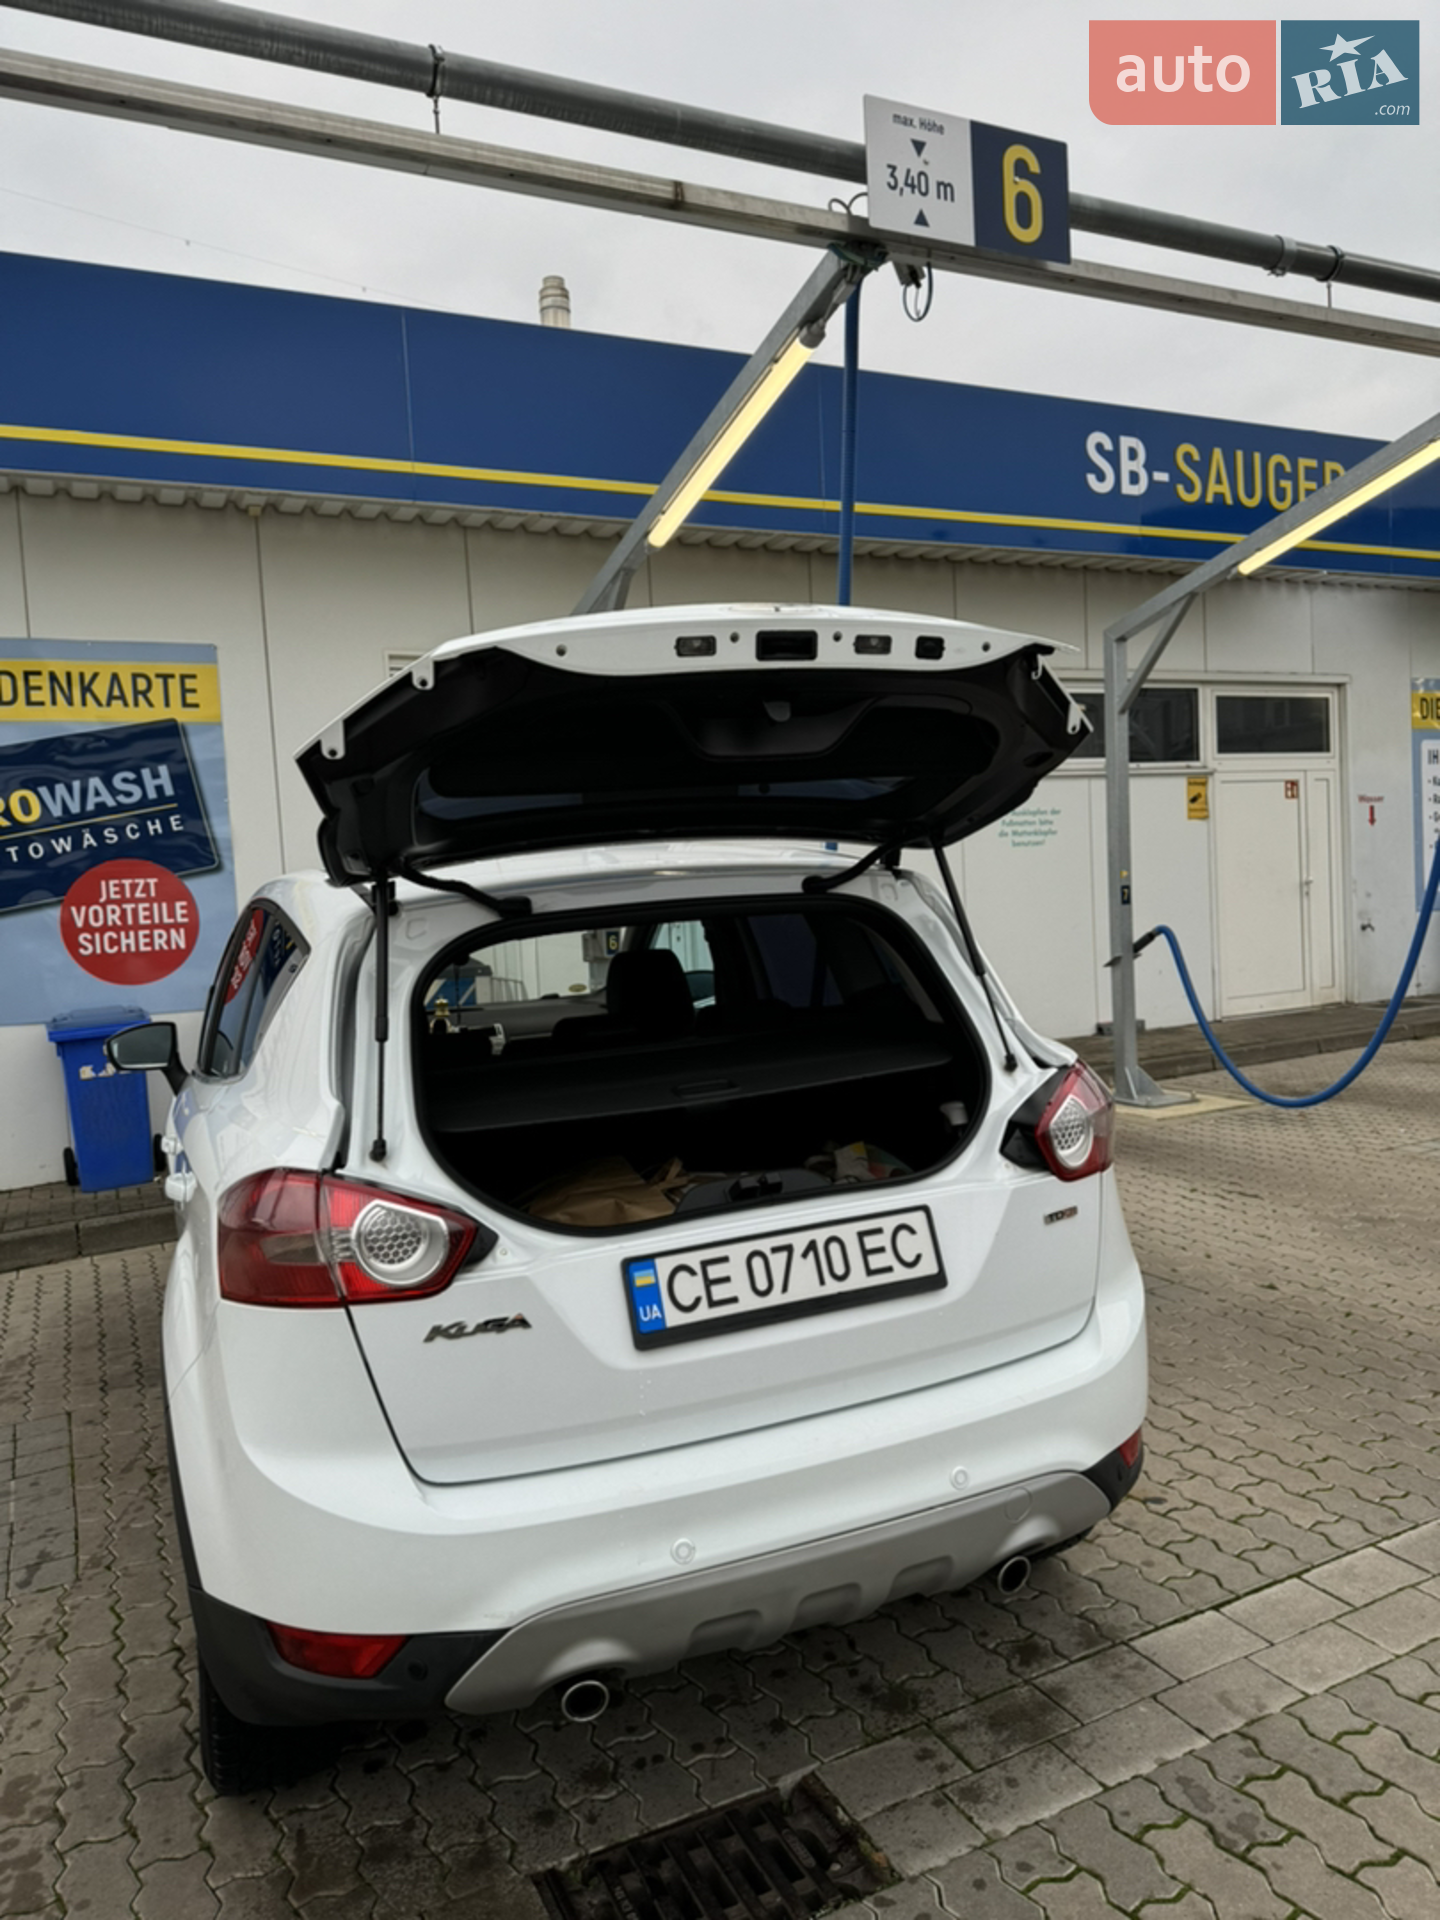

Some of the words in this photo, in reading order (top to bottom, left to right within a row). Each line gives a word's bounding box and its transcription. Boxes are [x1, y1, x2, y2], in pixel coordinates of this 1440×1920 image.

[892, 113, 917, 129] max.
[918, 117, 945, 136] Höhe
[886, 163, 930, 197] 3,40
[936, 179, 955, 203] m
[1002, 143, 1043, 243] 6
[0, 670, 200, 709] DENKARTE
[98, 878, 159, 903] JETZT
[71, 901, 189, 928] VORTEILE
[77, 928, 187, 956] SICHERN
[667, 1255, 740, 1313] CE
[745, 1235, 851, 1298] 0710
[856, 1223, 923, 1277] EC
[423, 1312, 533, 1343] KUGA
[639, 1304, 662, 1322] UA
